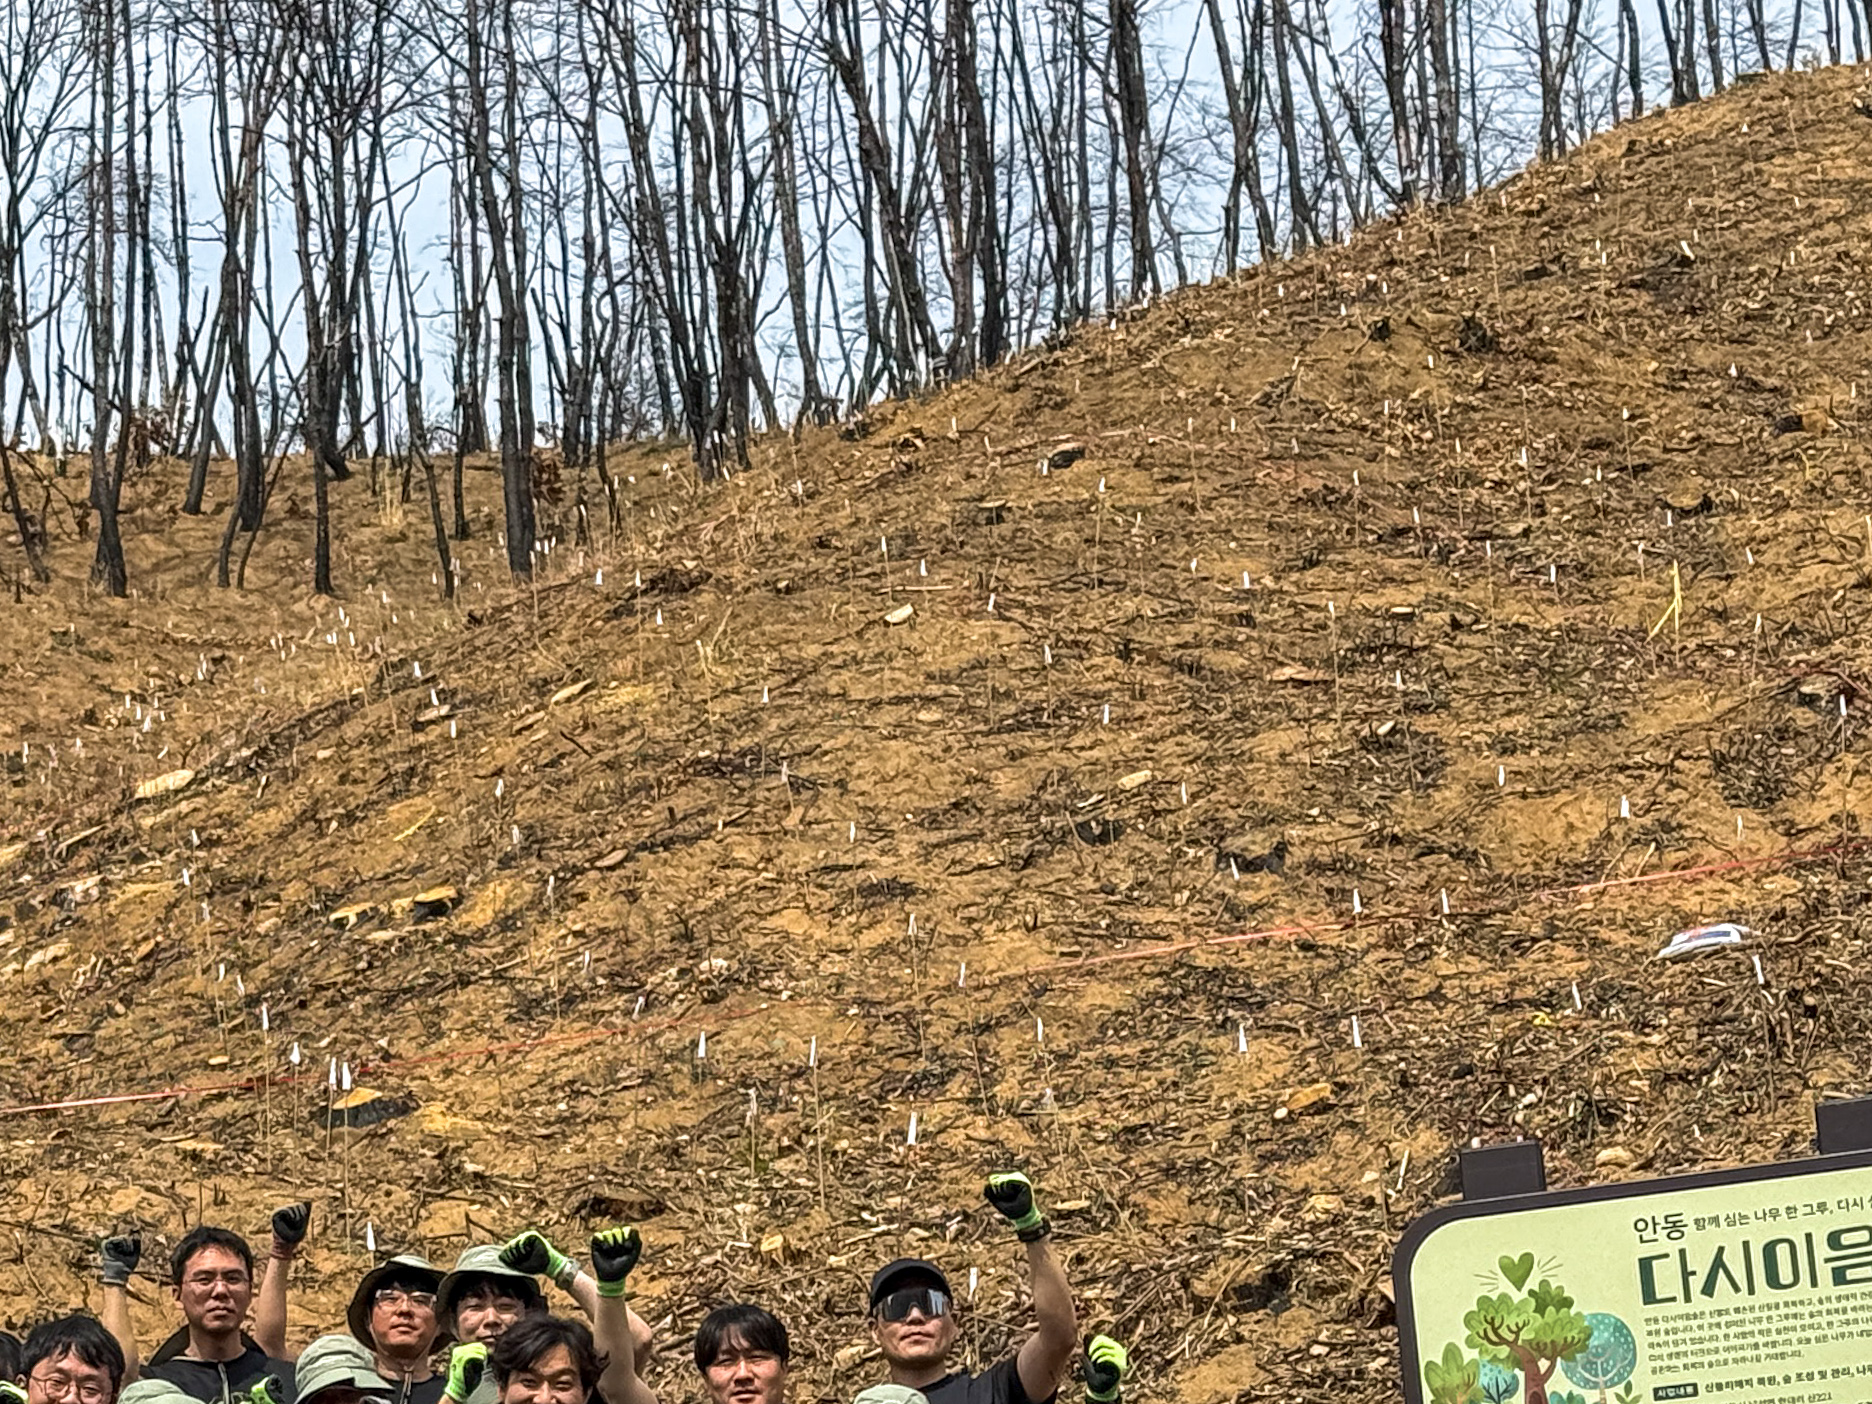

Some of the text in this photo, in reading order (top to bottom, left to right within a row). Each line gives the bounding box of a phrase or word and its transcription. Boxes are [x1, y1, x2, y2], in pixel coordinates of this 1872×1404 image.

[1634, 1212, 1689, 1244] 안동
[1694, 1214, 1721, 1231] 함께
[1724, 1212, 1751, 1228] 심는
[1754, 1207, 1782, 1223] 나무
[1785, 1206, 1799, 1220] 한
[1837, 1196, 1865, 1213] 다시
